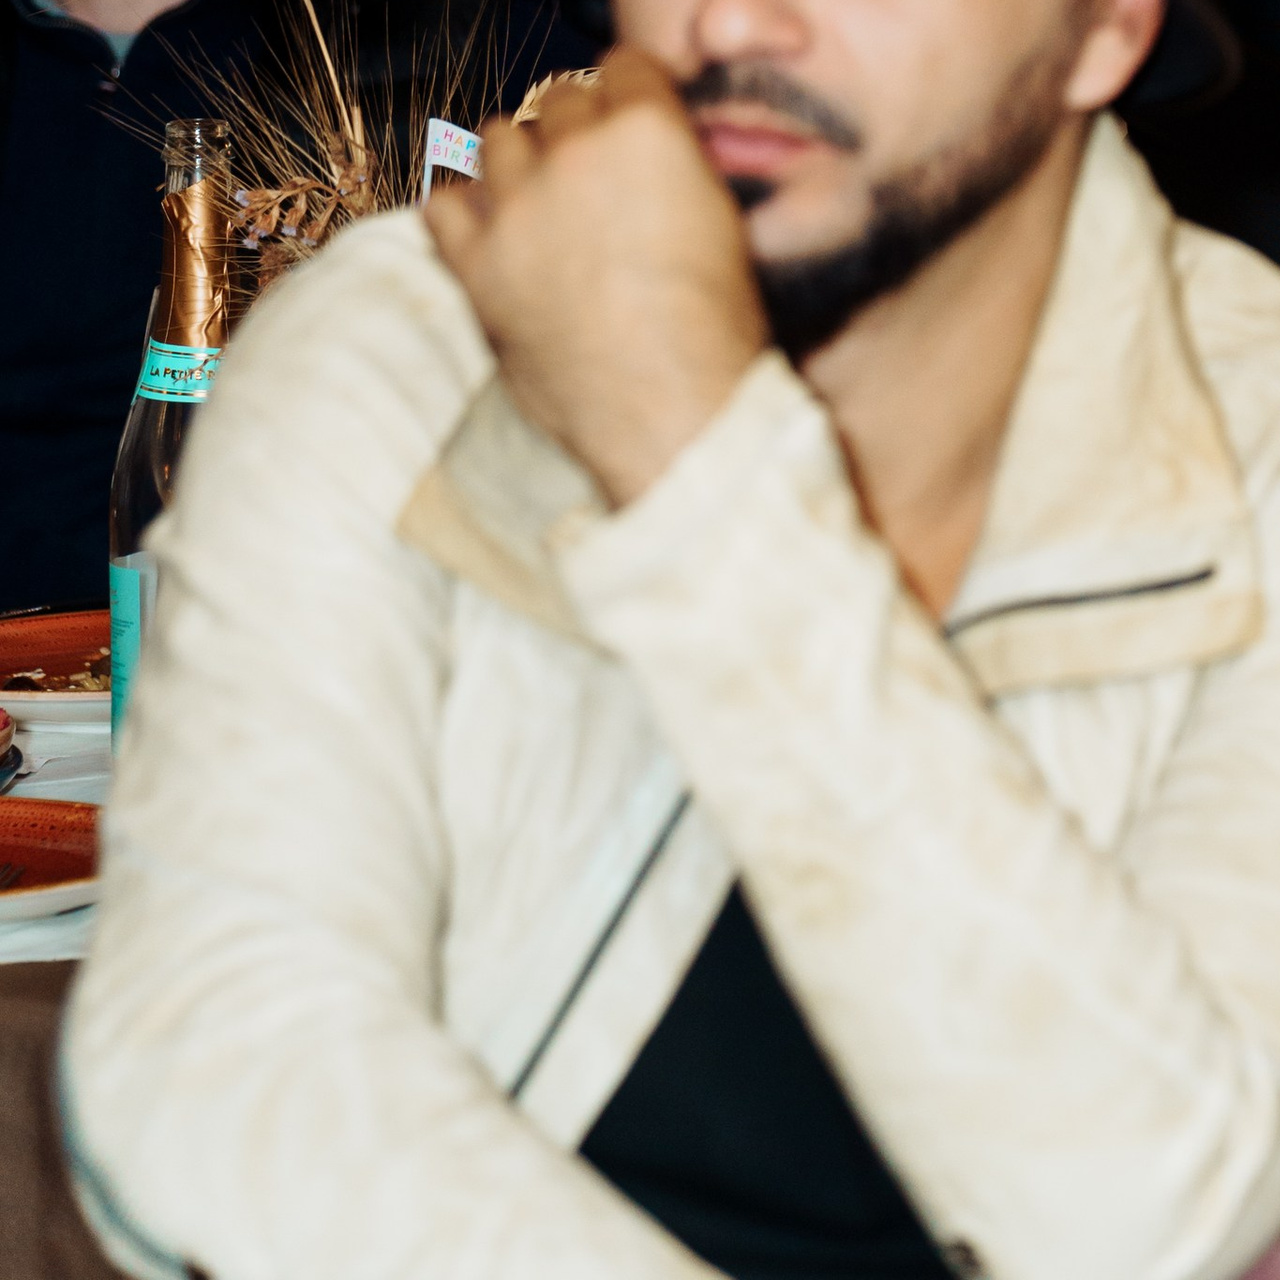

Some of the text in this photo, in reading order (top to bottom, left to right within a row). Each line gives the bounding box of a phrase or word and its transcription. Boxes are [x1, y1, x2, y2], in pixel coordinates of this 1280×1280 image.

[444, 129, 481, 154] HAP
[150, 365, 160, 377] LA
[163, 367, 203, 380] PETITE
